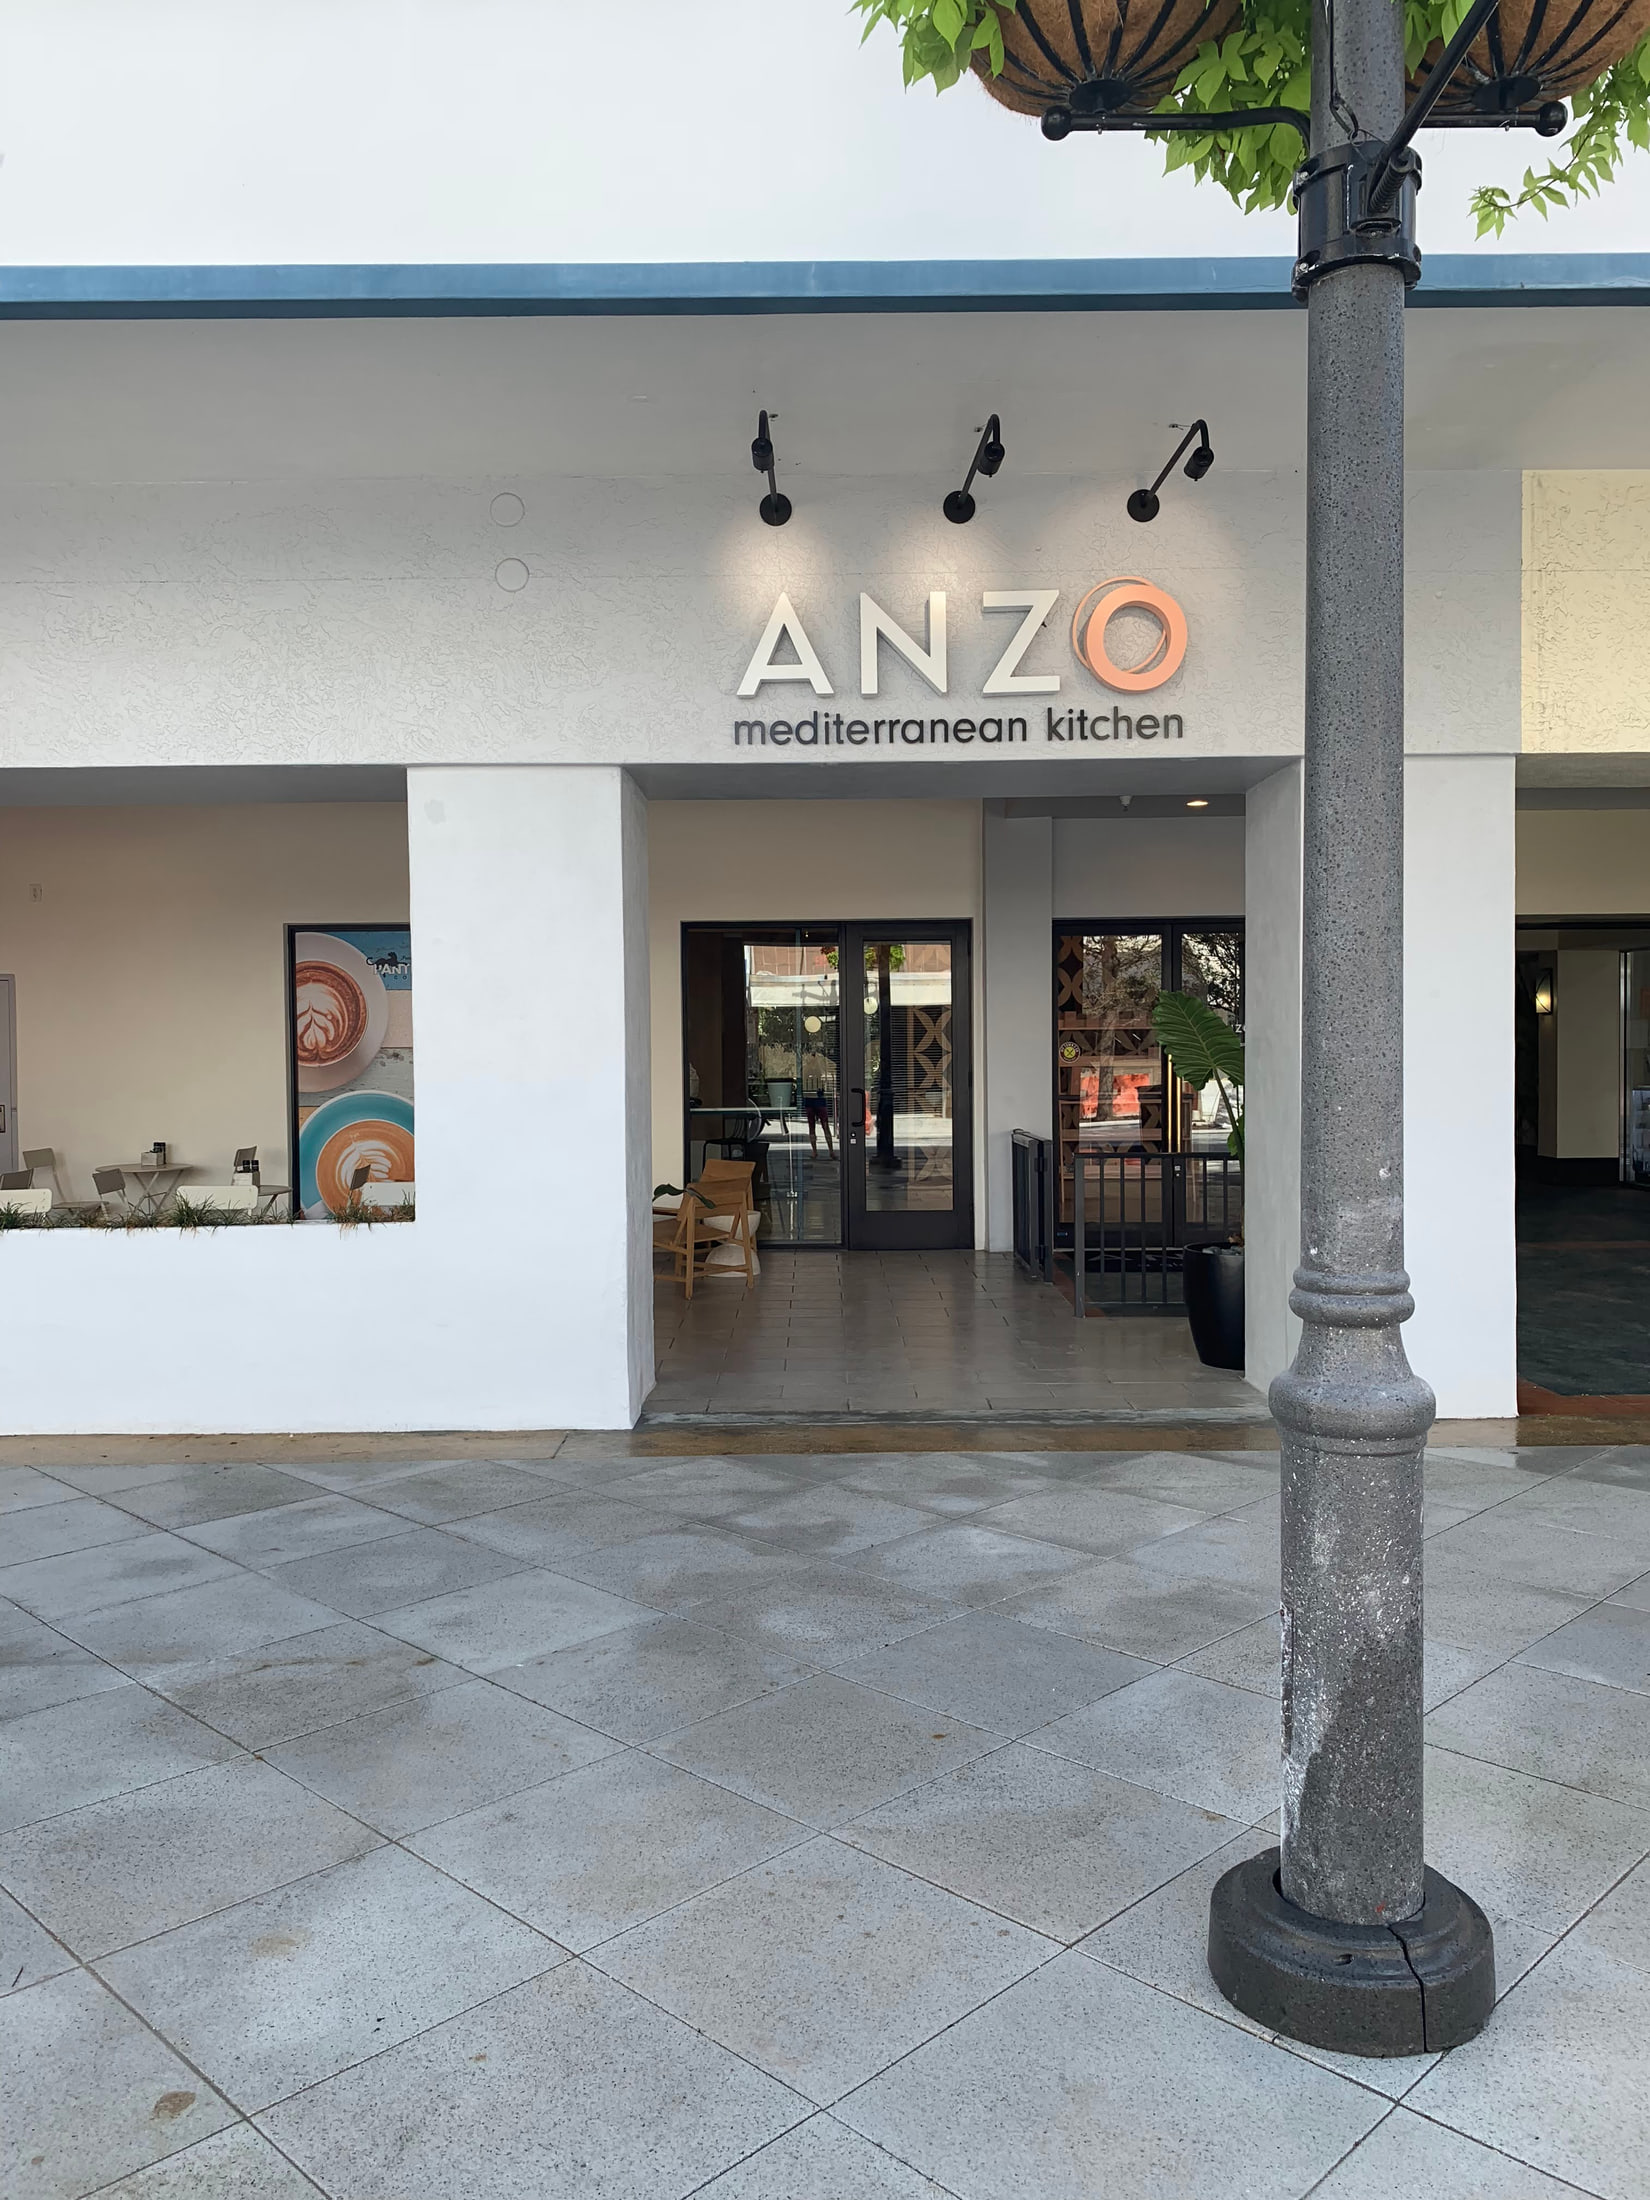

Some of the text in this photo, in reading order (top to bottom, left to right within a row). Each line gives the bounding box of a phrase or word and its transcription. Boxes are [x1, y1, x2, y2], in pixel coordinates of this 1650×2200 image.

[735, 576, 1188, 698] ANZO
[734, 706, 1184, 745] mediterranean kitchen
